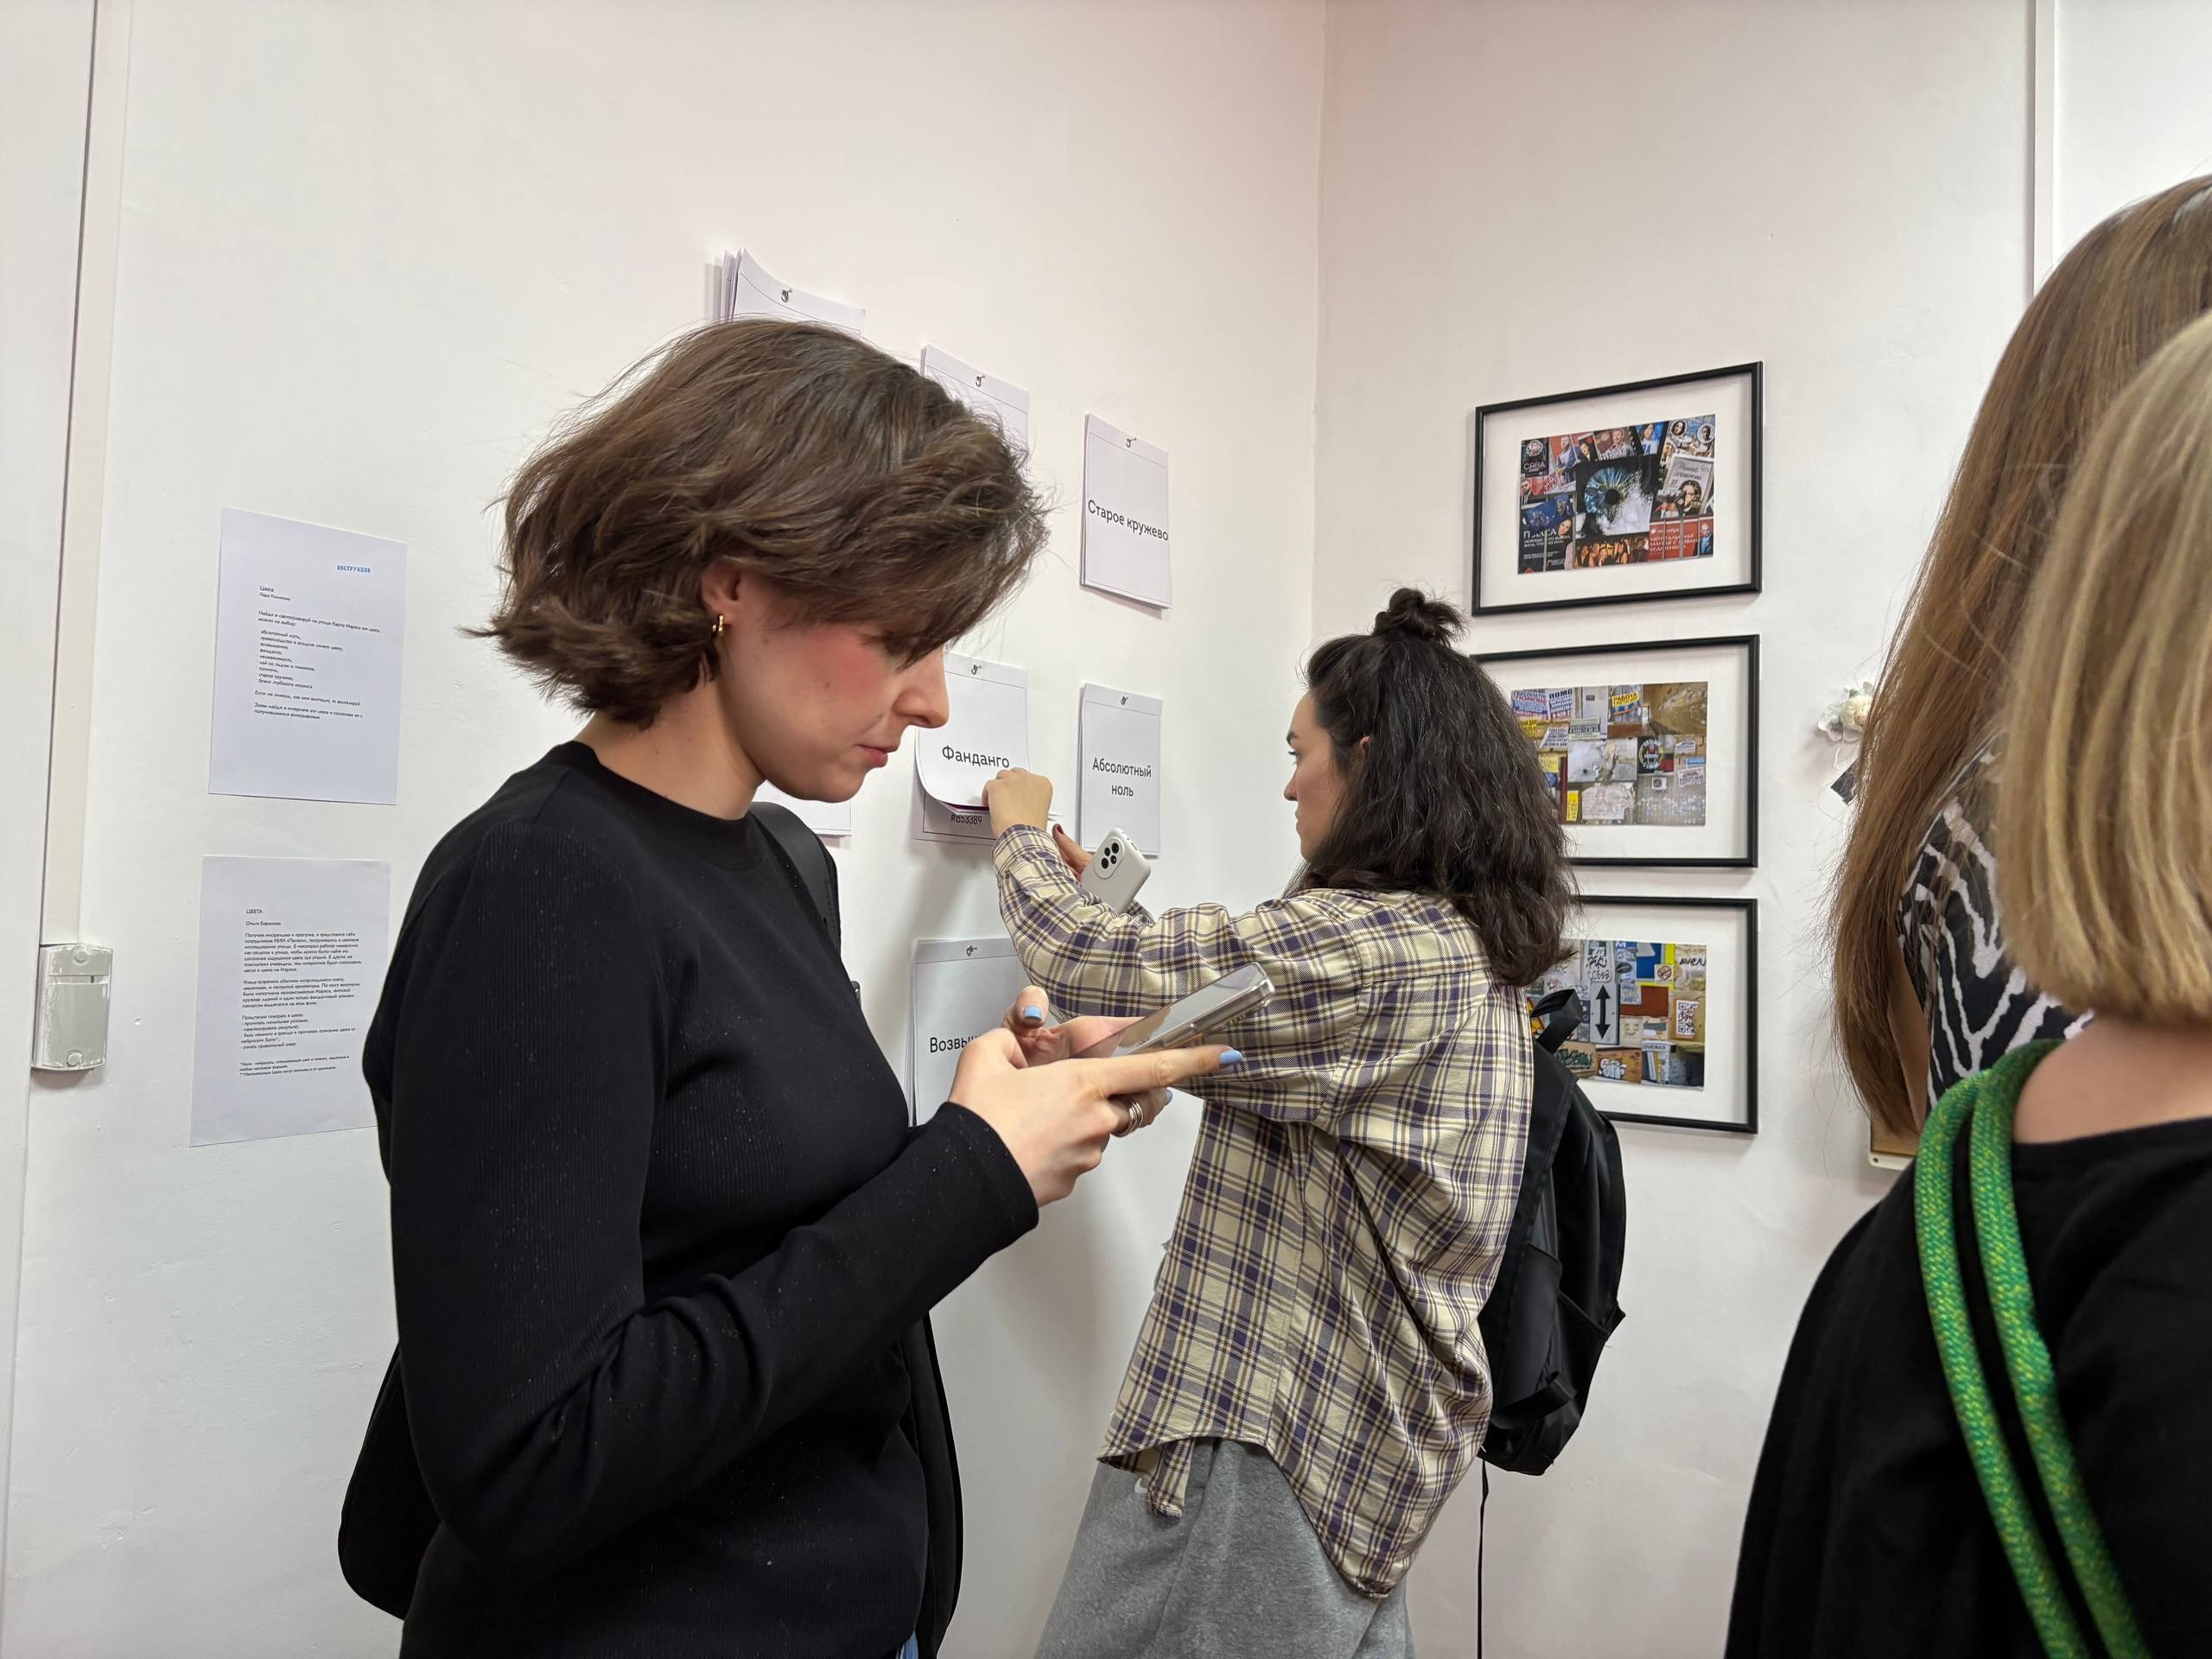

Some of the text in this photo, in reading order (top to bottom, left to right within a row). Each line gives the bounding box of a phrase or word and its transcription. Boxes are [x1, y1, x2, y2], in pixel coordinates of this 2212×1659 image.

[1088, 499, 1169, 541] Старое кружево
[942, 745, 1010, 768] Фанданго
[1092, 757, 1152, 778] Абсолютный
[1111, 785, 1135, 797] ноль
[930, 1035, 982, 1053] Возвы
